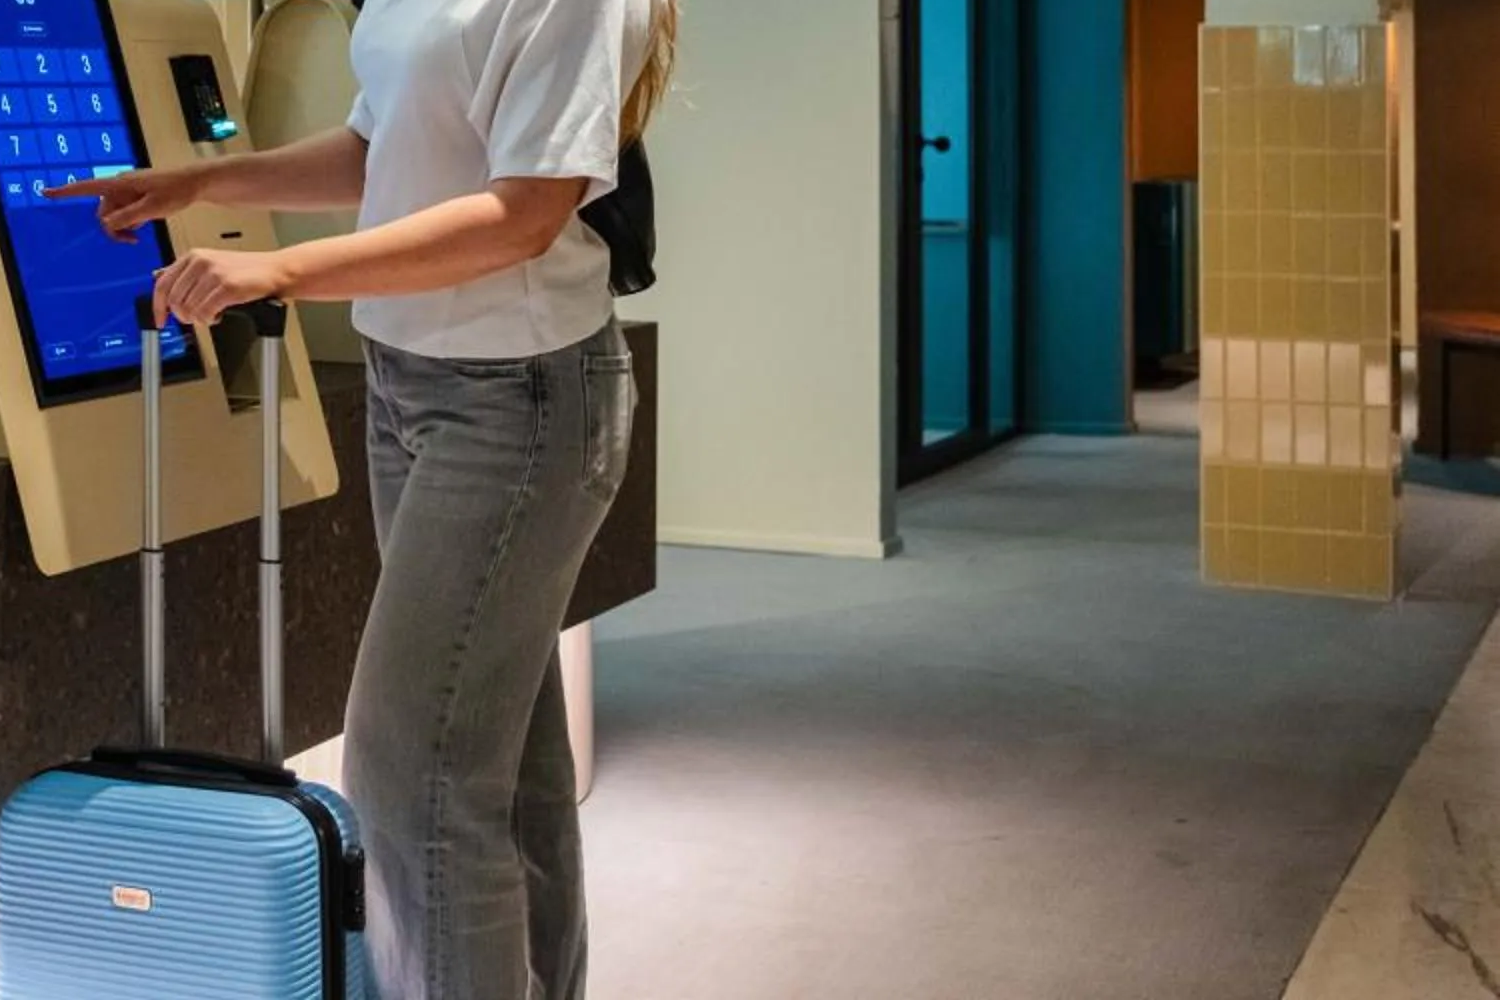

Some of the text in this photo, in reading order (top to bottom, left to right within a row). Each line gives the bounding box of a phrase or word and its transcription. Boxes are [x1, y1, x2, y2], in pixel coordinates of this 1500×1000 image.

[36, 53, 48, 74] 2
[81, 54, 92, 74] 3
[1, 94, 11, 115] 4
[46, 93, 58, 114] 5
[9, 135, 20, 156] 7
[101, 132, 112, 153] 9
